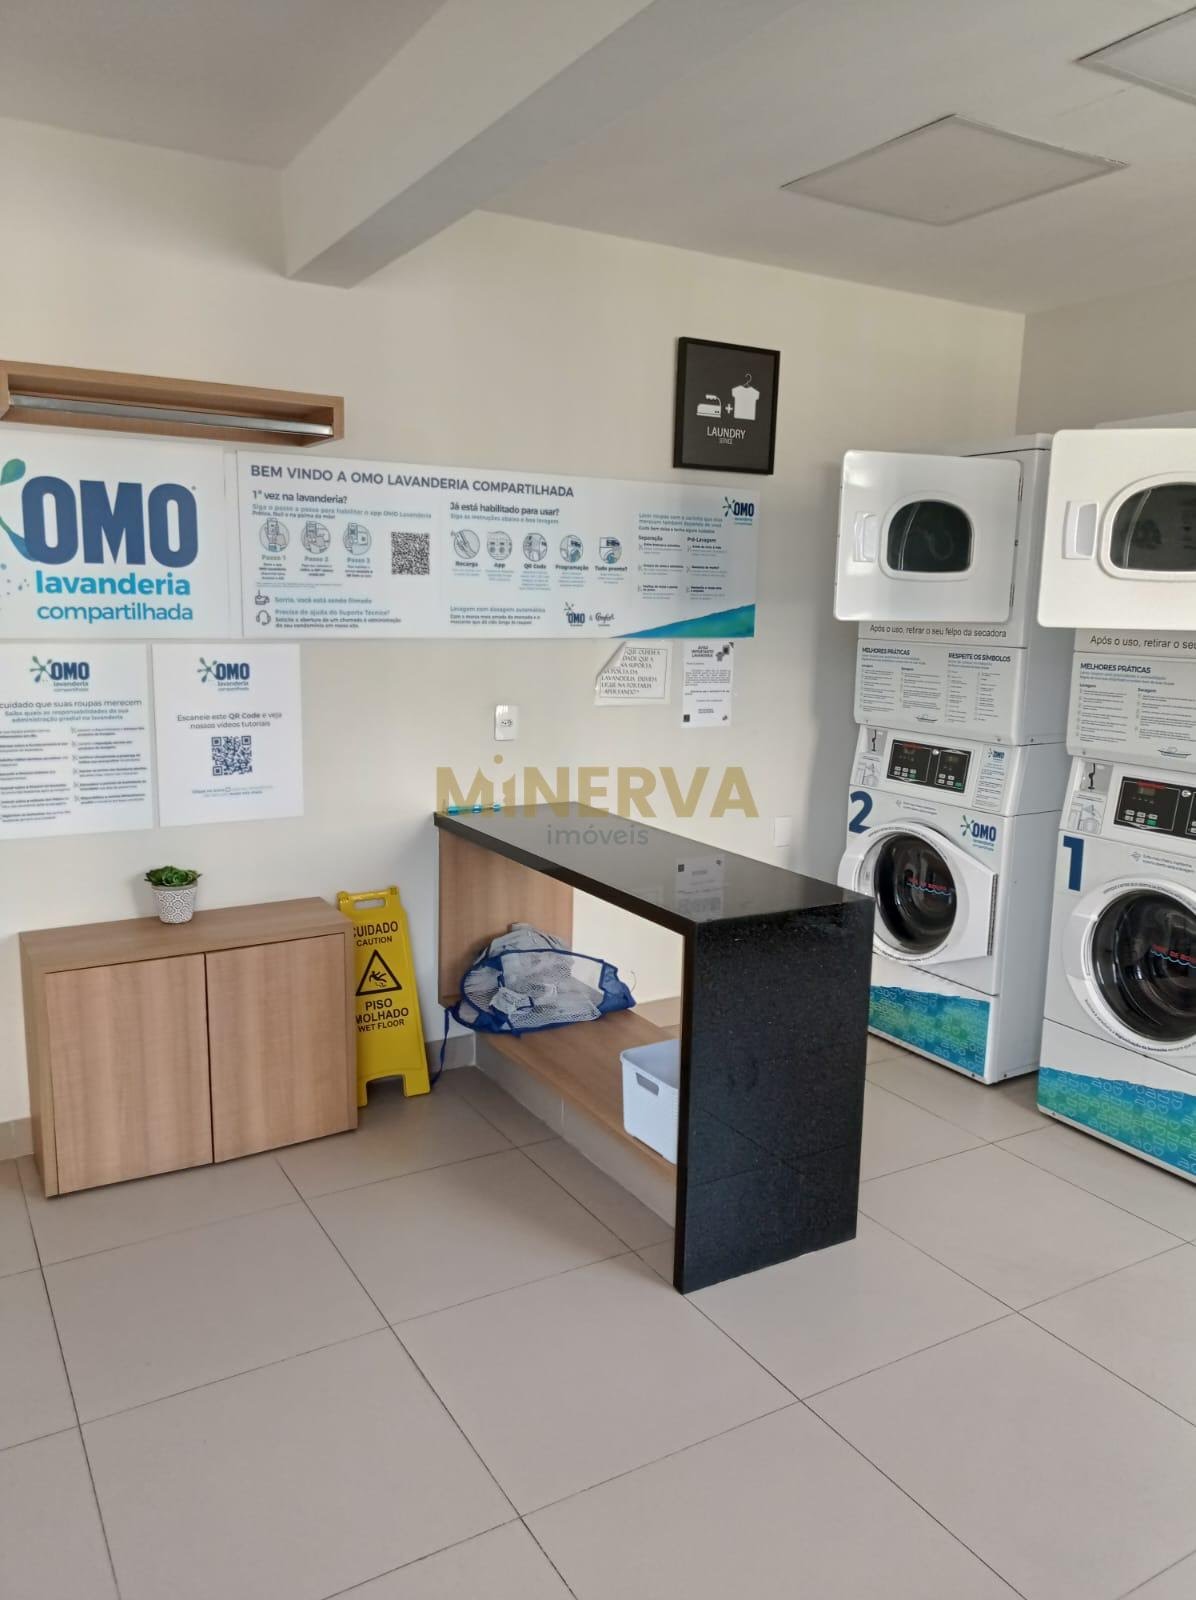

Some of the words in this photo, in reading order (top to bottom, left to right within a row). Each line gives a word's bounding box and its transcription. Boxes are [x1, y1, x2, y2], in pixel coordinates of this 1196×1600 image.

[706, 426, 746, 439] LAUNDRY
[251, 465, 283, 478] BEM
[287, 467, 333, 481] VINDO
[337, 471, 347, 482] A
[351, 472, 384, 485] OMO
[387, 476, 469, 491] LAVANDERIA
[472, 480, 574, 497] COMPARTILHADA
[264, 492, 280, 501] vez
[282, 493, 294, 501] na
[296, 494, 348, 504] lavanderia?
[450, 502, 460, 511] Já
[461, 503, 478, 512] está
[480, 504, 519, 514] habilitado
[521, 508, 538, 516] para
[540, 508, 560, 517] usar?
[734, 502, 754, 517] OMO
[22, 476, 198, 568] OMO
[455, 560, 478, 568] Recarga
[555, 563, 589, 571] Programação
[36, 570, 191, 595] lavanderia
[37, 602, 193, 624] compartilhada
[568, 612, 585, 624] OMO
[870, 624, 885, 633] Após
[906, 626, 925, 634] retirar
[945, 627, 961, 638] felpo
[963, 628, 972, 636] da
[974, 630, 1007, 638] secadora
[1090, 635, 1112, 647] Após
[1122, 637, 1141, 648] uso,
[1143, 638, 1171, 648] retirar
[1173, 641, 1180, 649] o
[887, 648, 910, 656] PRÁTICAS
[948, 652, 973, 660] RESPEITE
[973, 653, 982, 661] OS
[982, 652, 1012, 663] SÍMBOLOS
[51, 662, 90, 680] OMO
[216, 663, 250, 680] OMO
[1080, 662, 1117, 671] MELHORES
[1117, 664, 1152, 674] PRÁTICAS
[74, 700, 102, 709] roupas
[104, 699, 142, 707] merecem
[177, 713, 210, 721] Escaneie
[228, 713, 240, 721] QR
[241, 711, 260, 720] Code
[268, 711, 282, 721] veja
[190, 722, 215, 730] nossos
[216, 721, 240, 729] vídeos
[241, 720, 271, 729] tutoriais
[849, 790, 873, 833] 2
[972, 822, 997, 842] OMO
[1063, 835, 1084, 892] 1
[356, 935, 393, 947] CAUTION
[365, 998, 393, 1011] PISO
[355, 1007, 409, 1025] MOLHADO
[357, 1022, 375, 1033] WET
[377, 1017, 405, 1030] FLOOR
